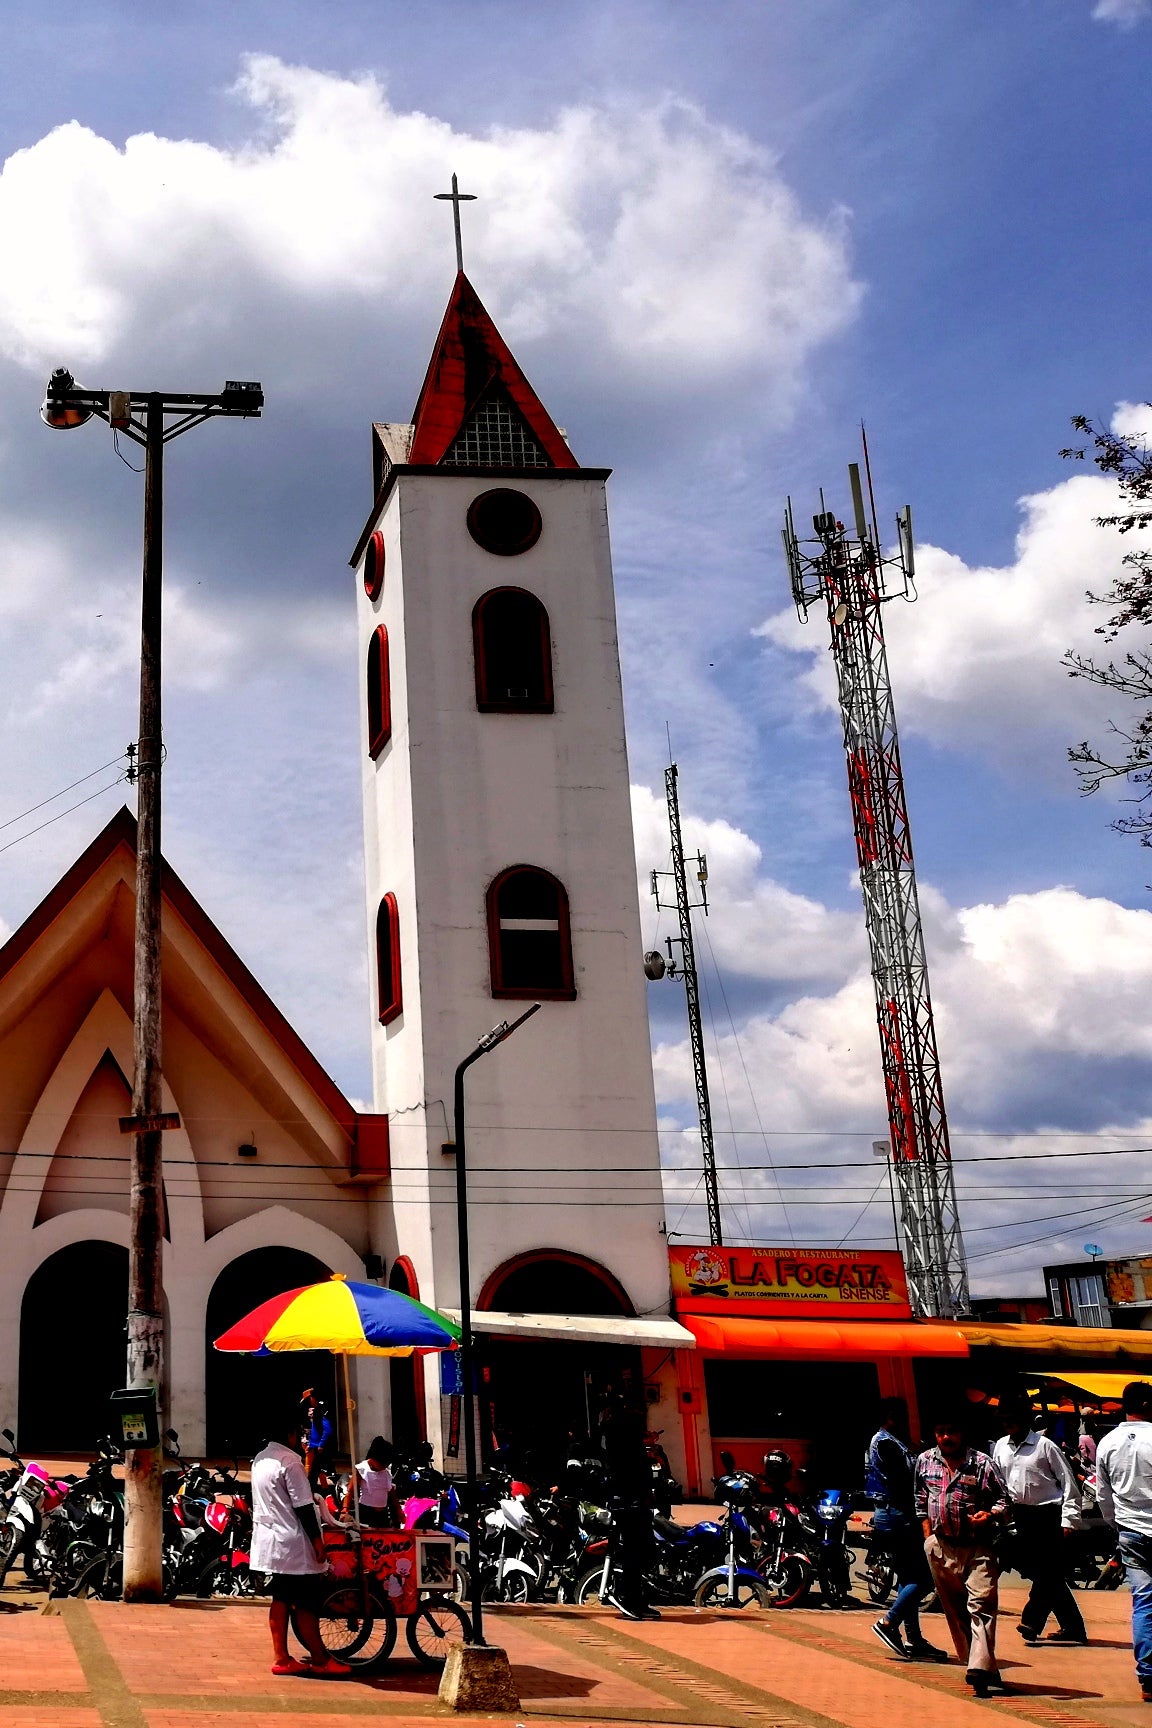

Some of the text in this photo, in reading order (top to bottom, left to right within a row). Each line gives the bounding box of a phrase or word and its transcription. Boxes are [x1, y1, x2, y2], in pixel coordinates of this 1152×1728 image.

[751, 1249, 861, 1260] ASADERO Y RESTAURANTE
[729, 1257, 773, 1286] LA
[775, 1258, 892, 1288] FOGATA
[839, 1287, 890, 1301] ISNENSE
